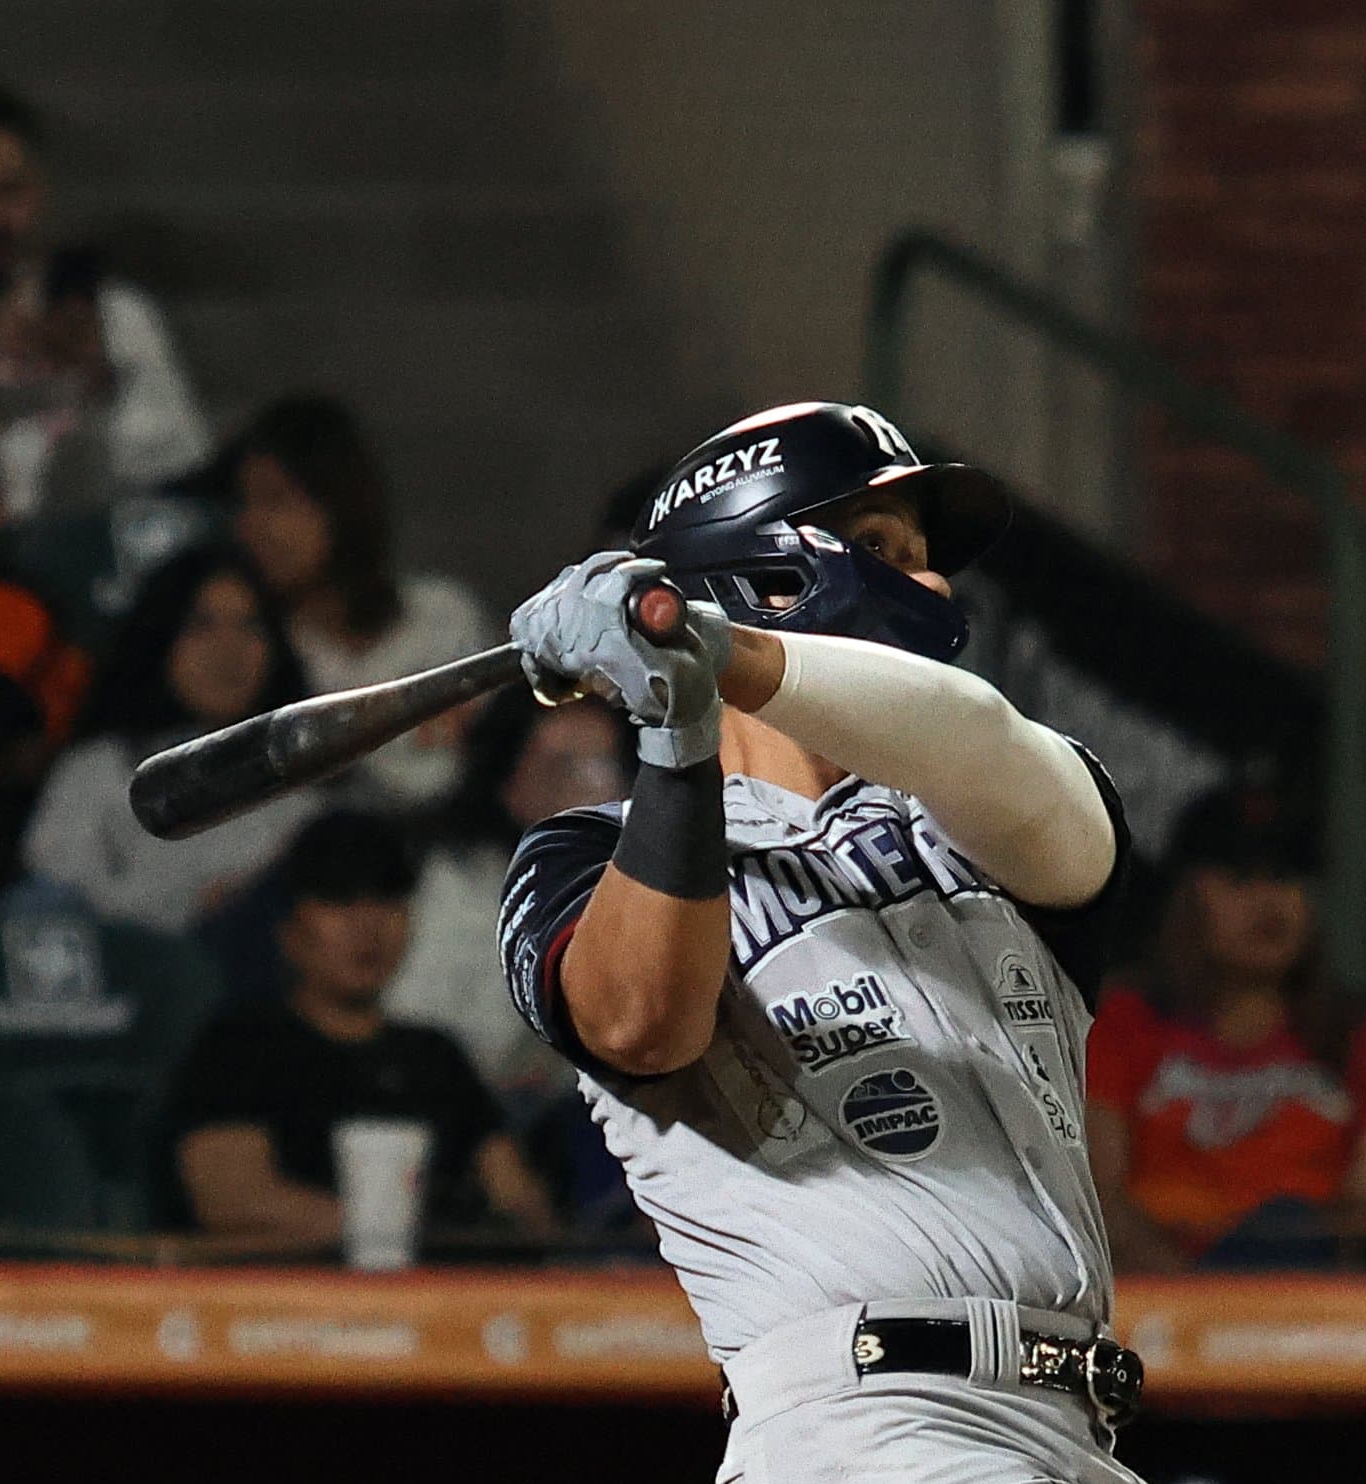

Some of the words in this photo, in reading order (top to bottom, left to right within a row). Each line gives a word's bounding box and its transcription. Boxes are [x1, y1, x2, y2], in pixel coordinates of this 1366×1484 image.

[699, 479, 736, 505] BEYOND
[734, 464, 785, 490] ALUMINUM
[772, 975, 887, 1037] Mobil
[791, 1015, 894, 1064] Super
[853, 1105, 939, 1139] IMPAC
